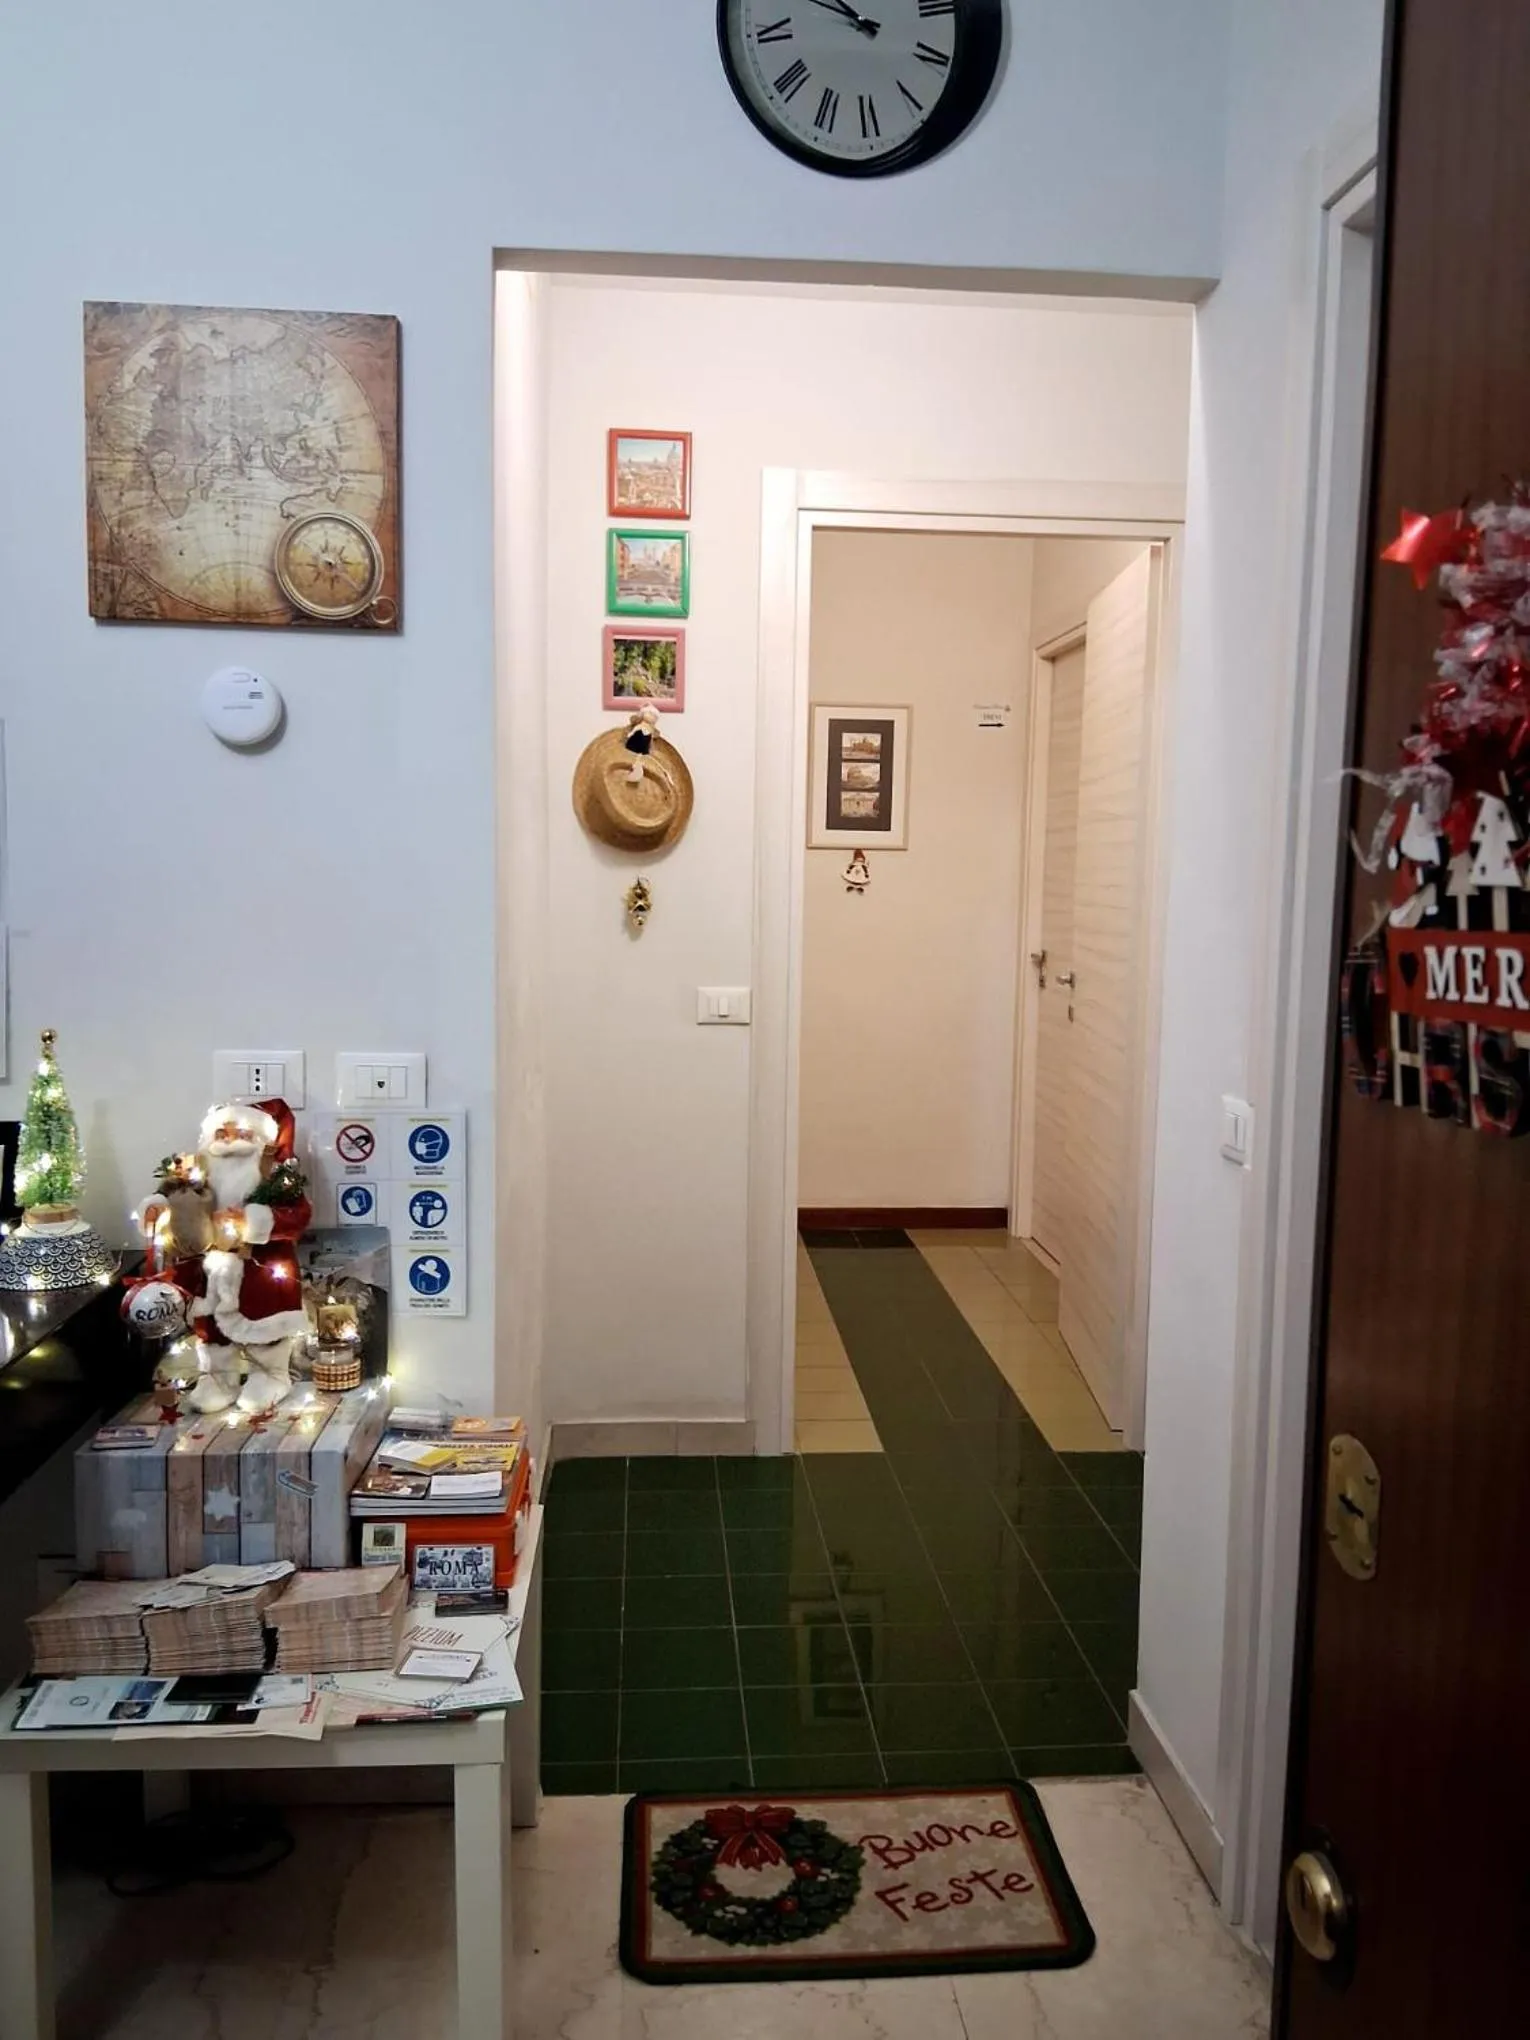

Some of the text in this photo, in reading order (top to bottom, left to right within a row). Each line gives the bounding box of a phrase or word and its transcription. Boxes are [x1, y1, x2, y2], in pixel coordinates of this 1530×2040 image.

[428, 1561, 480, 1576] ROMA
[857, 1819, 1019, 1870] Buone
[874, 1868, 1035, 1922] Feste
